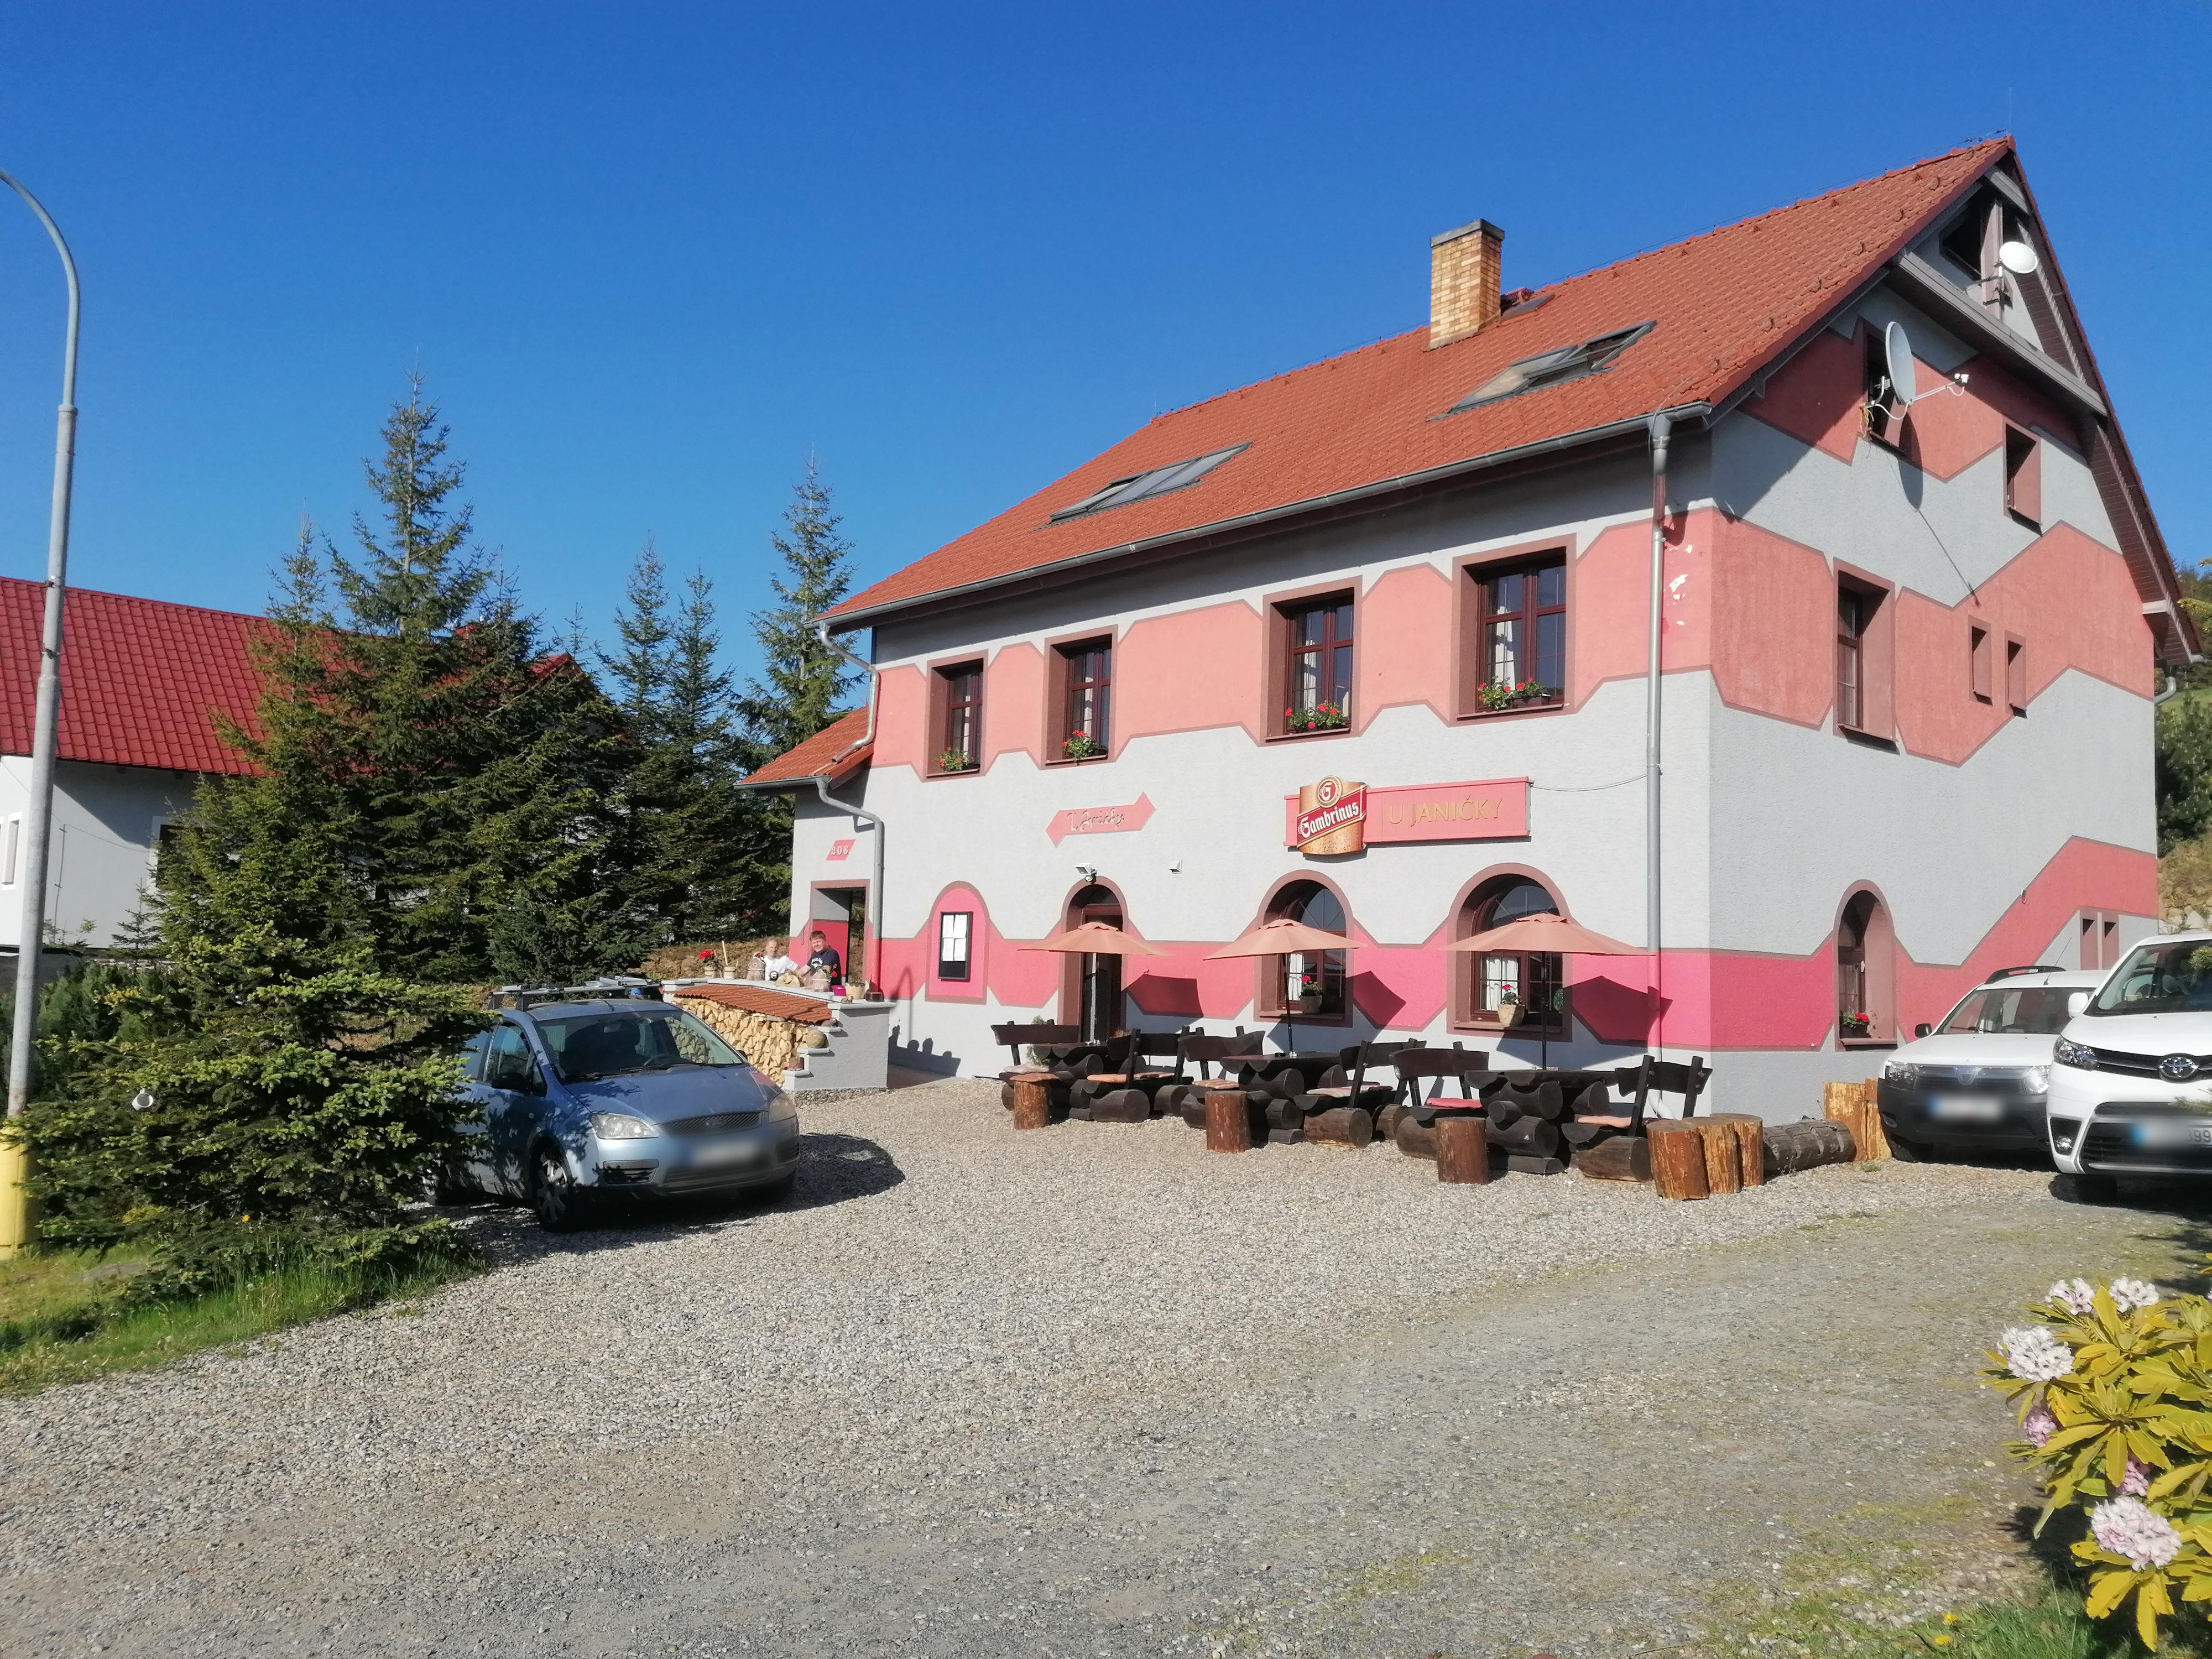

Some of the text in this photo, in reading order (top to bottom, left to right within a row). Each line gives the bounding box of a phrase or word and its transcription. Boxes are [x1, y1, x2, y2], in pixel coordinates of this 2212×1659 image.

[1297, 802, 1359, 838] Gambrinus
[1389, 794, 1503, 827] U JANIČKY
